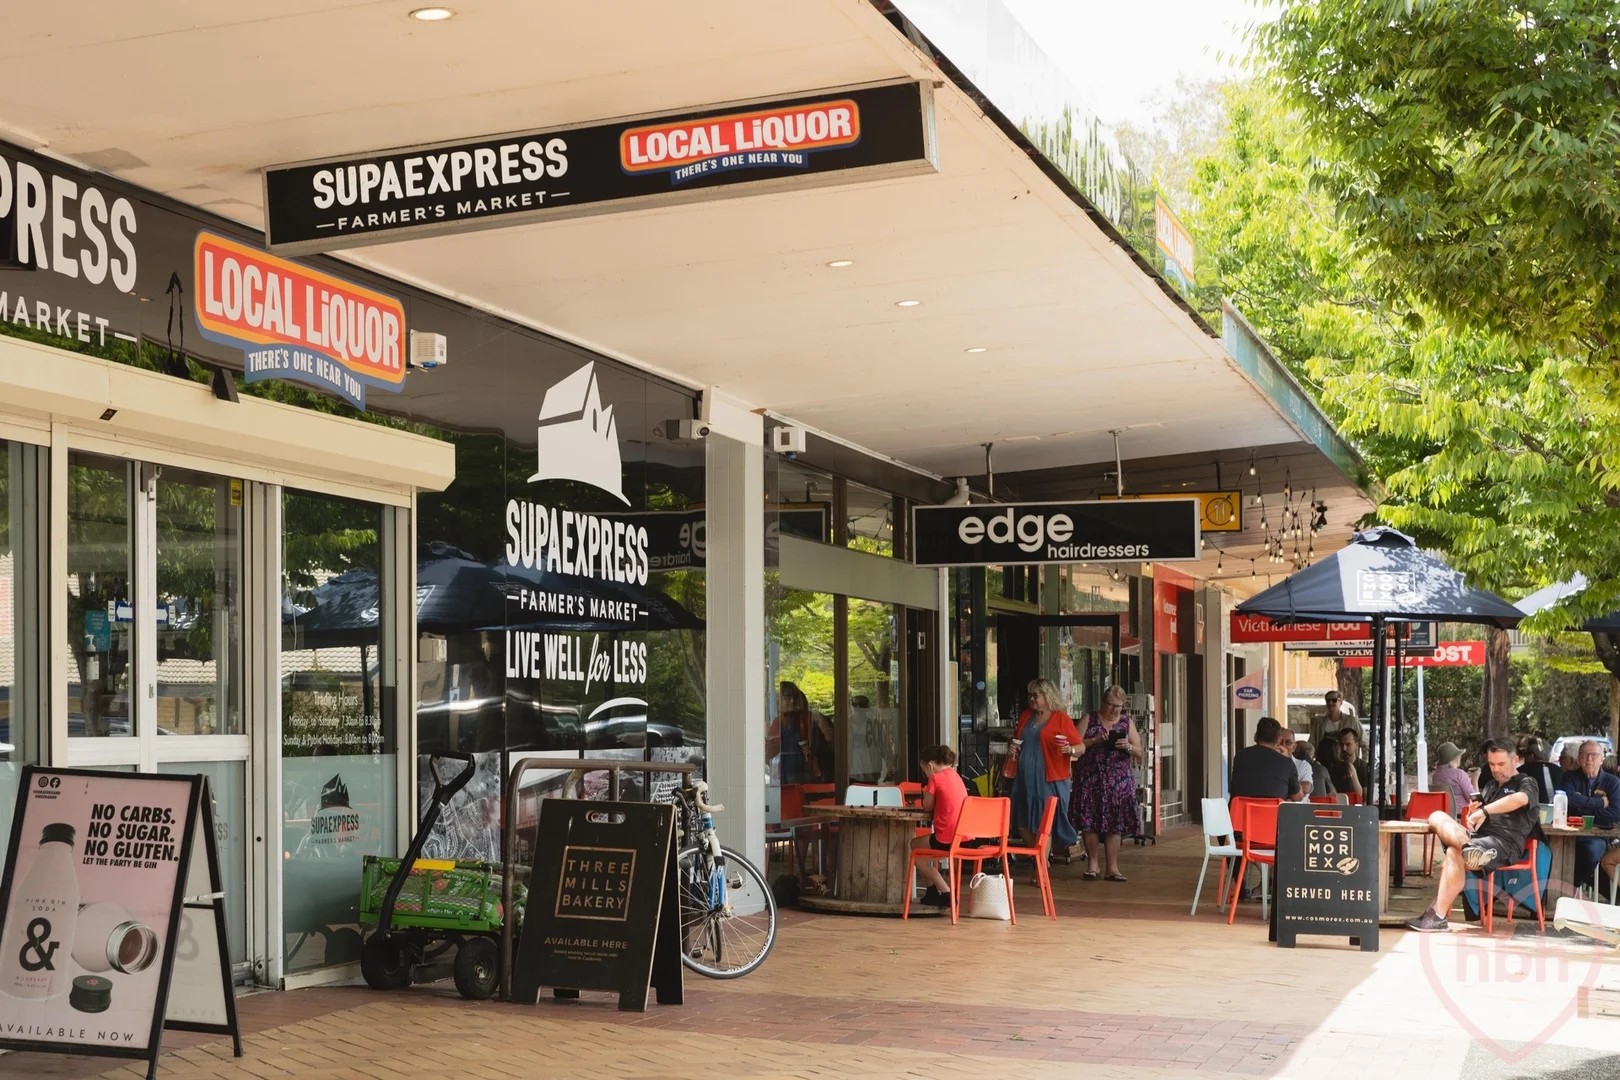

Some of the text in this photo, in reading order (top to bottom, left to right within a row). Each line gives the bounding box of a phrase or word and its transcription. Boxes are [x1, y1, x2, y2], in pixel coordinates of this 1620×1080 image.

[629, 124, 729, 165] LOCAL
[312, 138, 568, 210] SUPAEXPRESS
[674, 152, 803, 180] THERE'S ONE NEAR YOU
[338, 191, 547, 230] FARMER'S MARKET
[204, 250, 300, 340] LOCAL
[248, 348, 361, 401] THERE'S ONE NEAR YOU
[958, 507, 1074, 553] edge
[505, 498, 649, 586] SUPAEXPRESS
[1047, 543, 1150, 559] hairdressers
[520, 589, 638, 622] FARMER'S MARKET
[505, 630, 647, 695] LIVE WELL for LESS
[313, 690, 358, 709] Trading Hours
[91, 804, 175, 824] NO CARBS.
[87, 821, 175, 842] NO SUGAR.
[310, 814, 359, 835] SUPAEXPRESS
[1309, 829, 1349, 841] COS
[84, 839, 179, 862] NO GLUTEN.
[1308, 843, 1349, 855] MOR
[82, 857, 157, 869] LET THE PARTY BE GIN
[567, 859, 630, 875] THREE
[1308, 857, 1334, 868] EX
[564, 877, 627, 892] MILLS
[1286, 887, 1372, 901] SERVED HERE
[561, 895, 625, 909] BAKERY
[1285, 914, 1373, 924] www.cosmorex.com.au
[19, 917, 60, 971] &
[544, 936, 628, 949] AVAILABLE HERE
[97, 1031, 134, 1041] NOW
